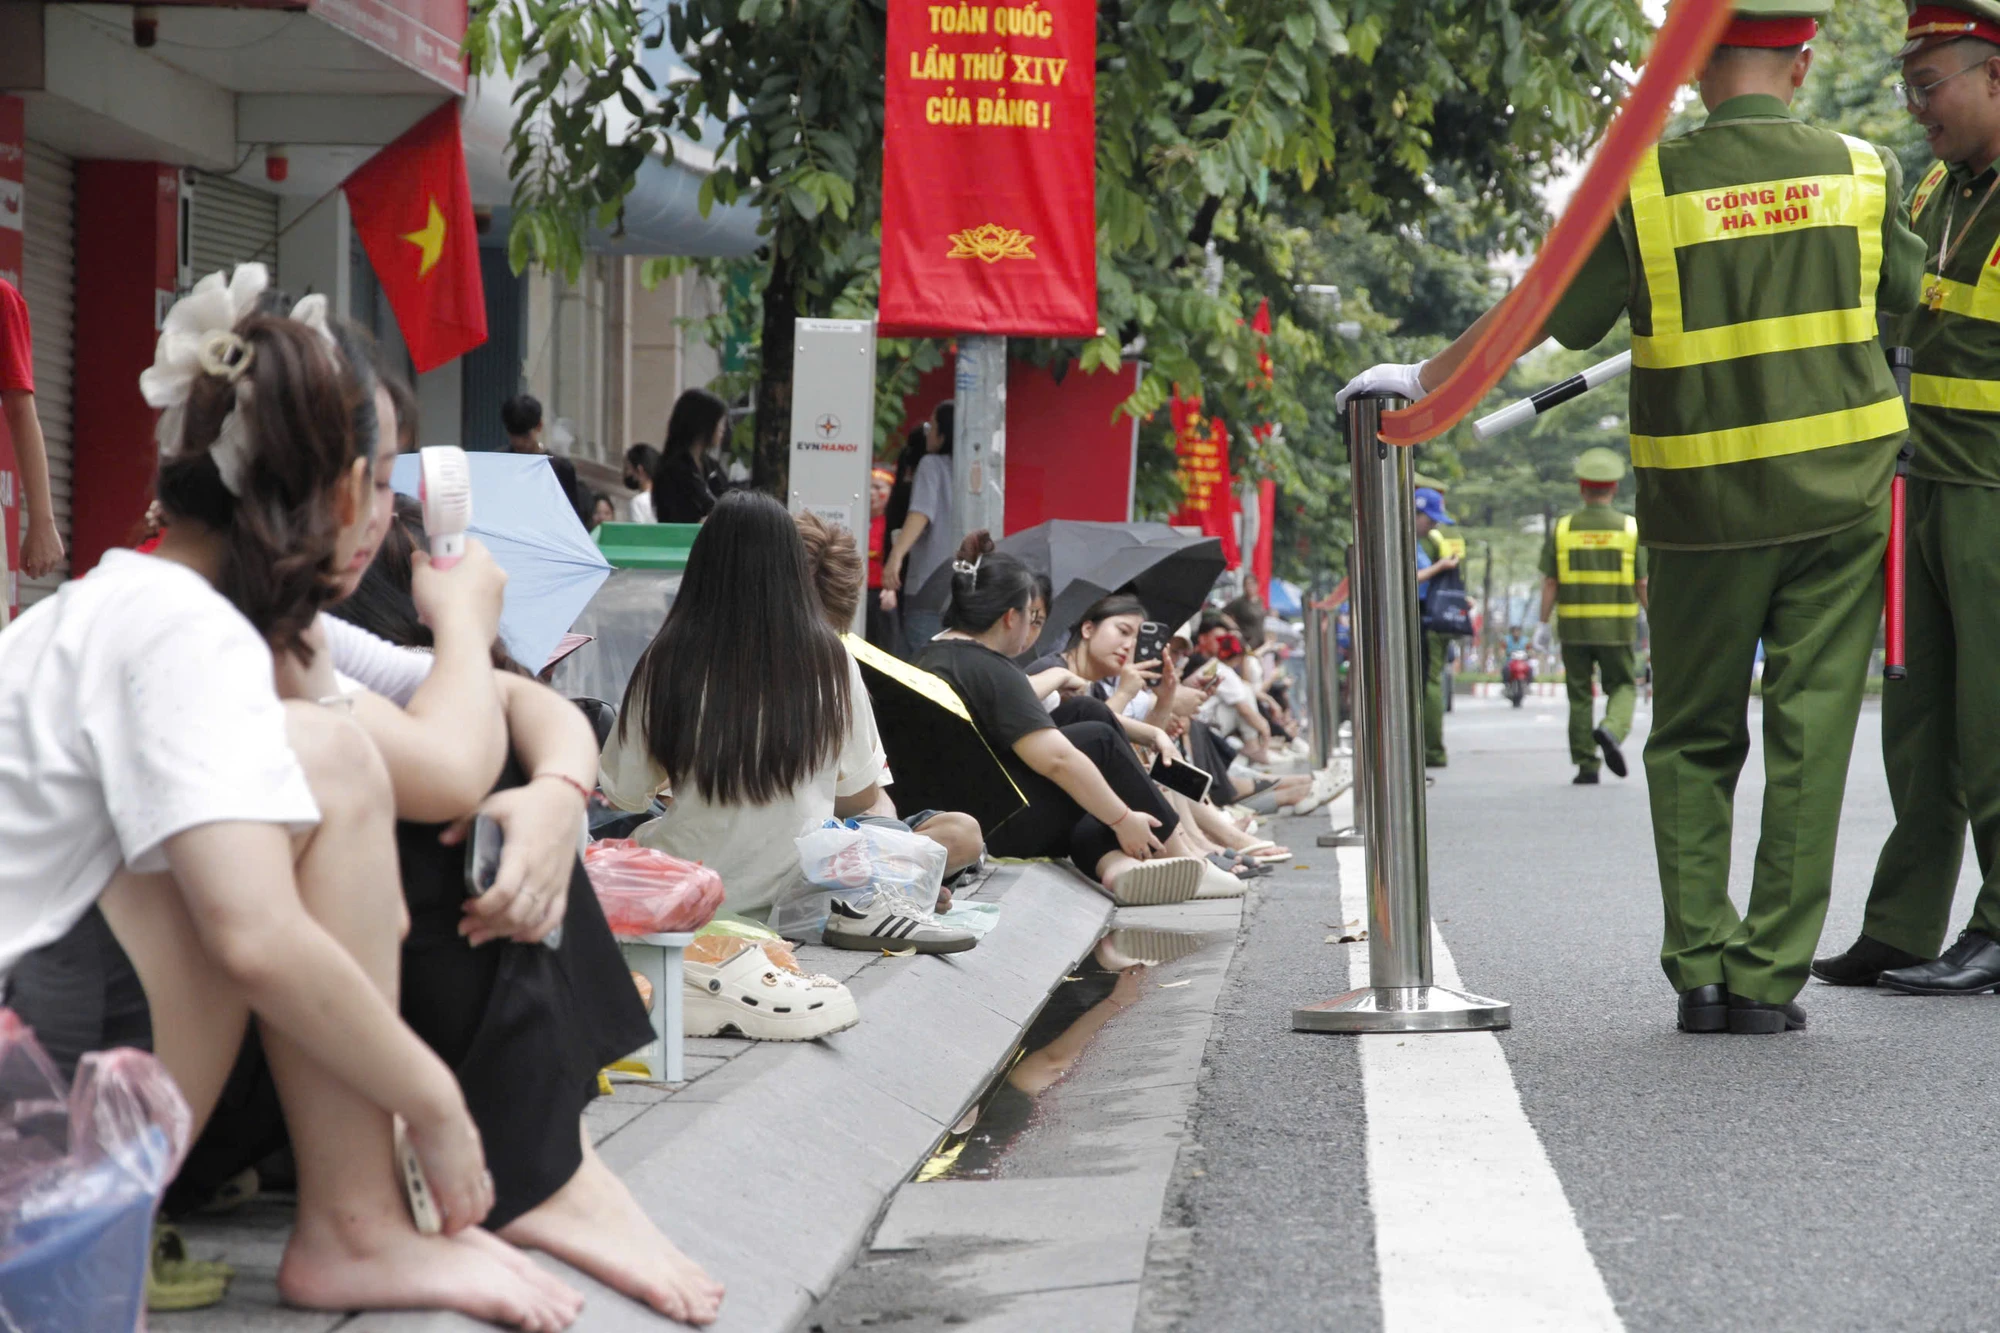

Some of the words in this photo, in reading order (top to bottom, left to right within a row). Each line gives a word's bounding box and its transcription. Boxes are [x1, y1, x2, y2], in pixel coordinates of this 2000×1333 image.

[928, 1, 988, 34] TOÀN
[994, 1, 1052, 38] QUỐC
[910, 44, 956, 80] LẦN
[961, 46, 1007, 81] THỨ
[1010, 54, 1068, 86] XIV
[925, 86, 972, 125] CỦA
[976, 87, 1039, 128] ĐẢNG
[1705, 189, 1776, 211] CÔNG
[1785, 183, 1820, 201] AN
[1722, 210, 1757, 230] HÀ
[1764, 204, 1808, 225] NỘI
